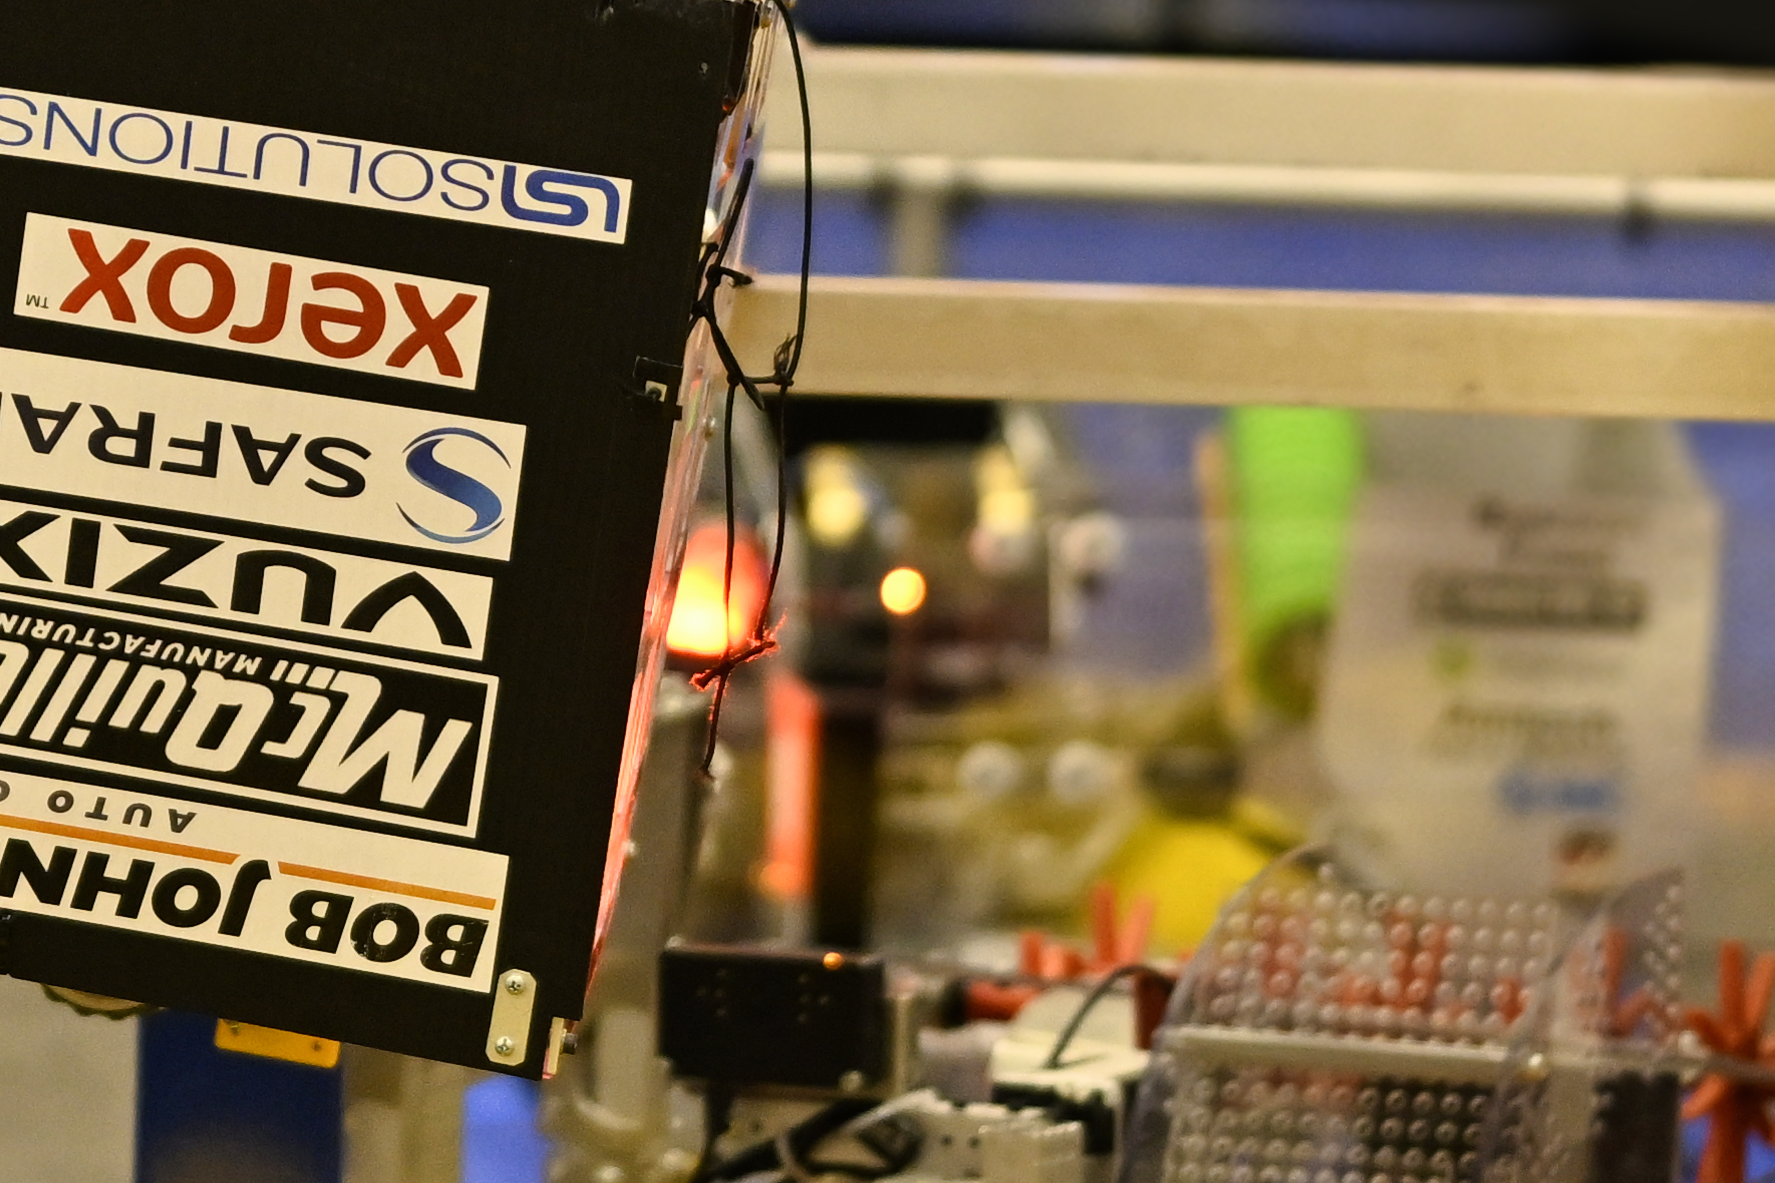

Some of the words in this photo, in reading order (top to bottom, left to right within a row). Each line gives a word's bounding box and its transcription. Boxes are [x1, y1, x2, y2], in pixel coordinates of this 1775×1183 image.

[59, 228, 478, 378] xerox
[47, 789, 196, 833] AUTO
[285, 889, 489, 977] BOB
